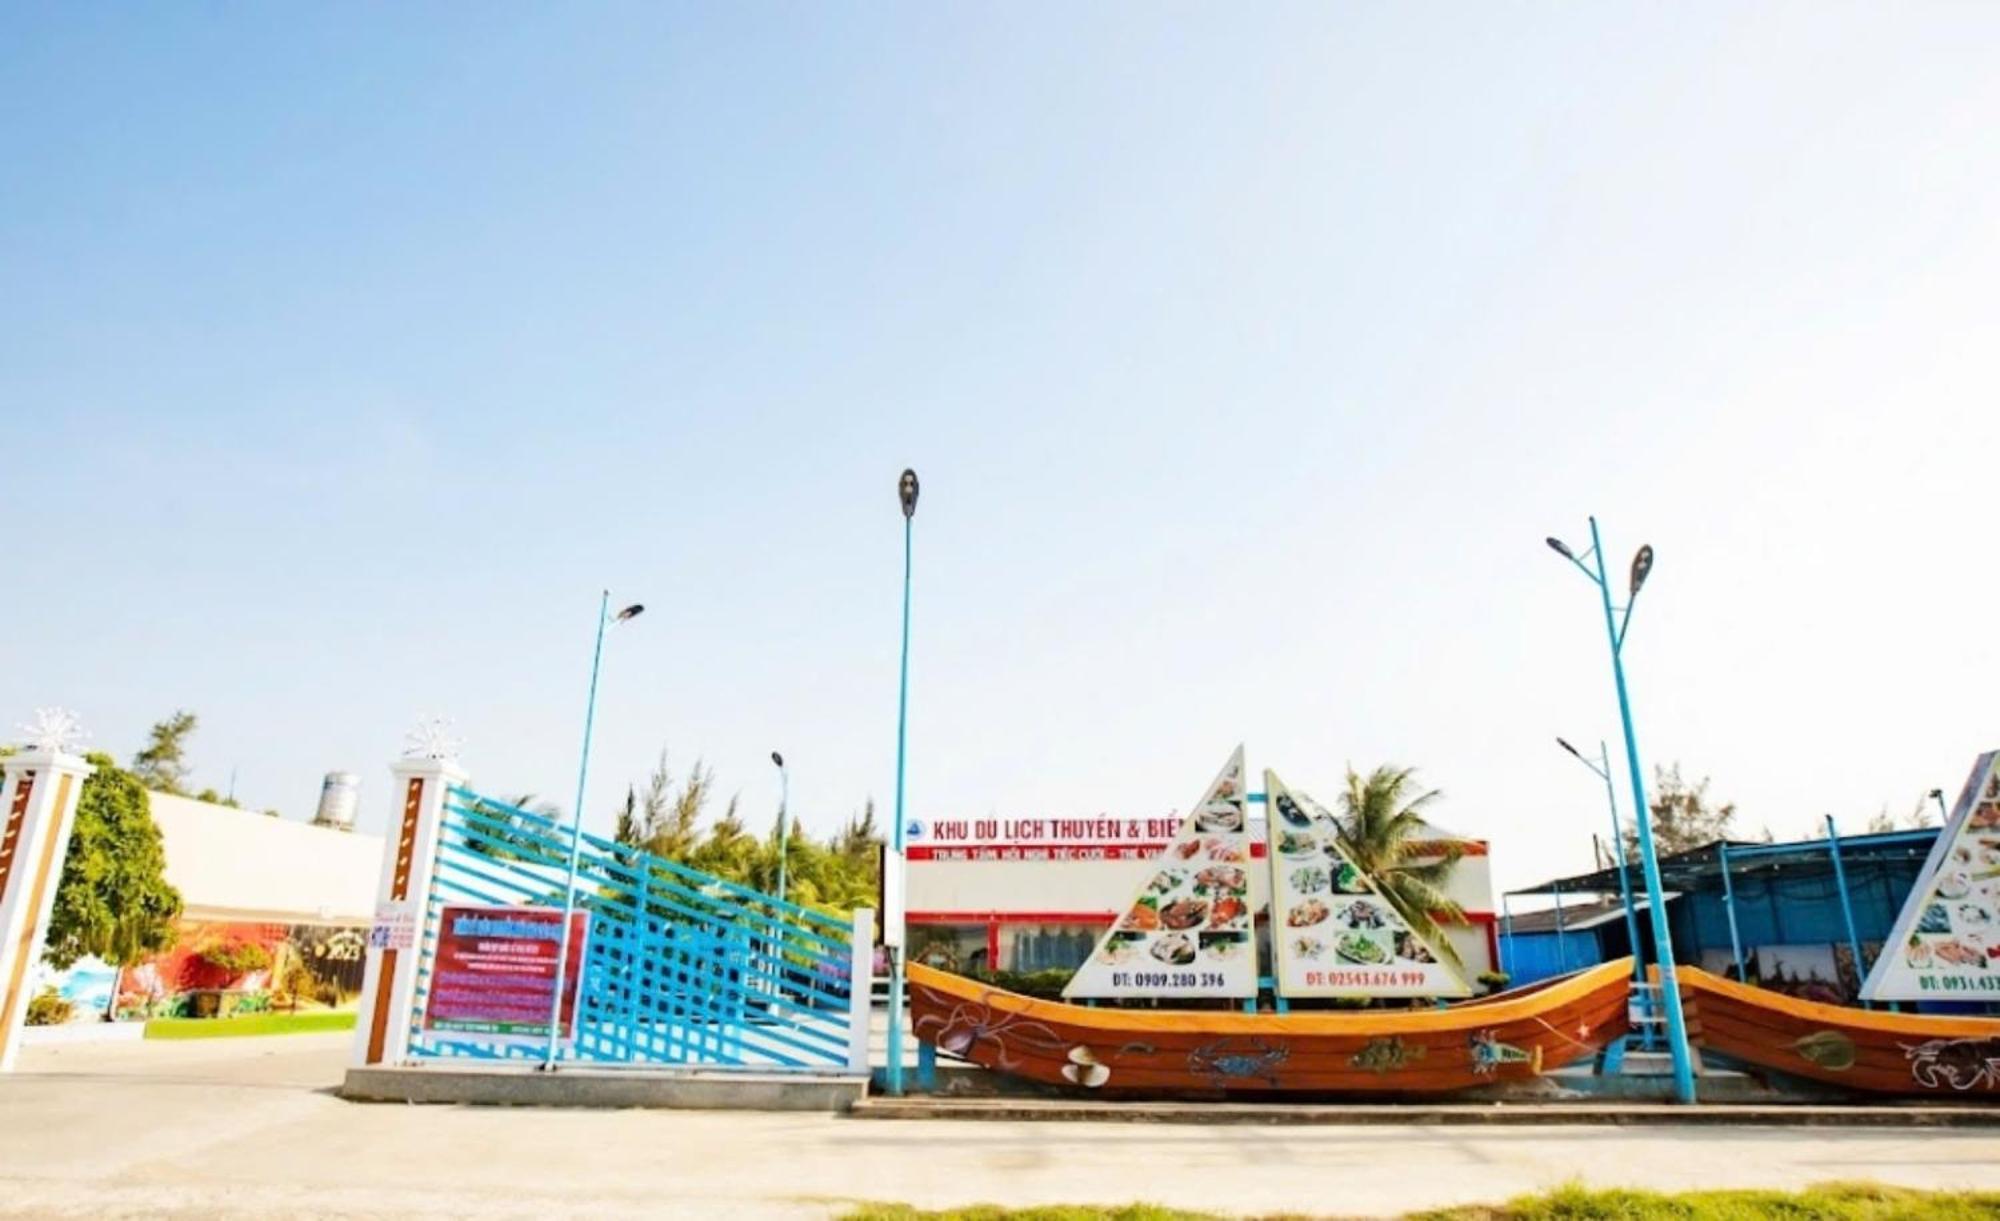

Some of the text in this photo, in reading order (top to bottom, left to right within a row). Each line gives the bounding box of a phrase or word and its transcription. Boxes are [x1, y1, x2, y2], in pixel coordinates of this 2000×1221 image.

[934, 820, 968, 840] KHU
[1127, 820, 1139, 838] &
[1135, 971, 1197, 987] 0909.280
[1200, 972, 1225, 987] 396
